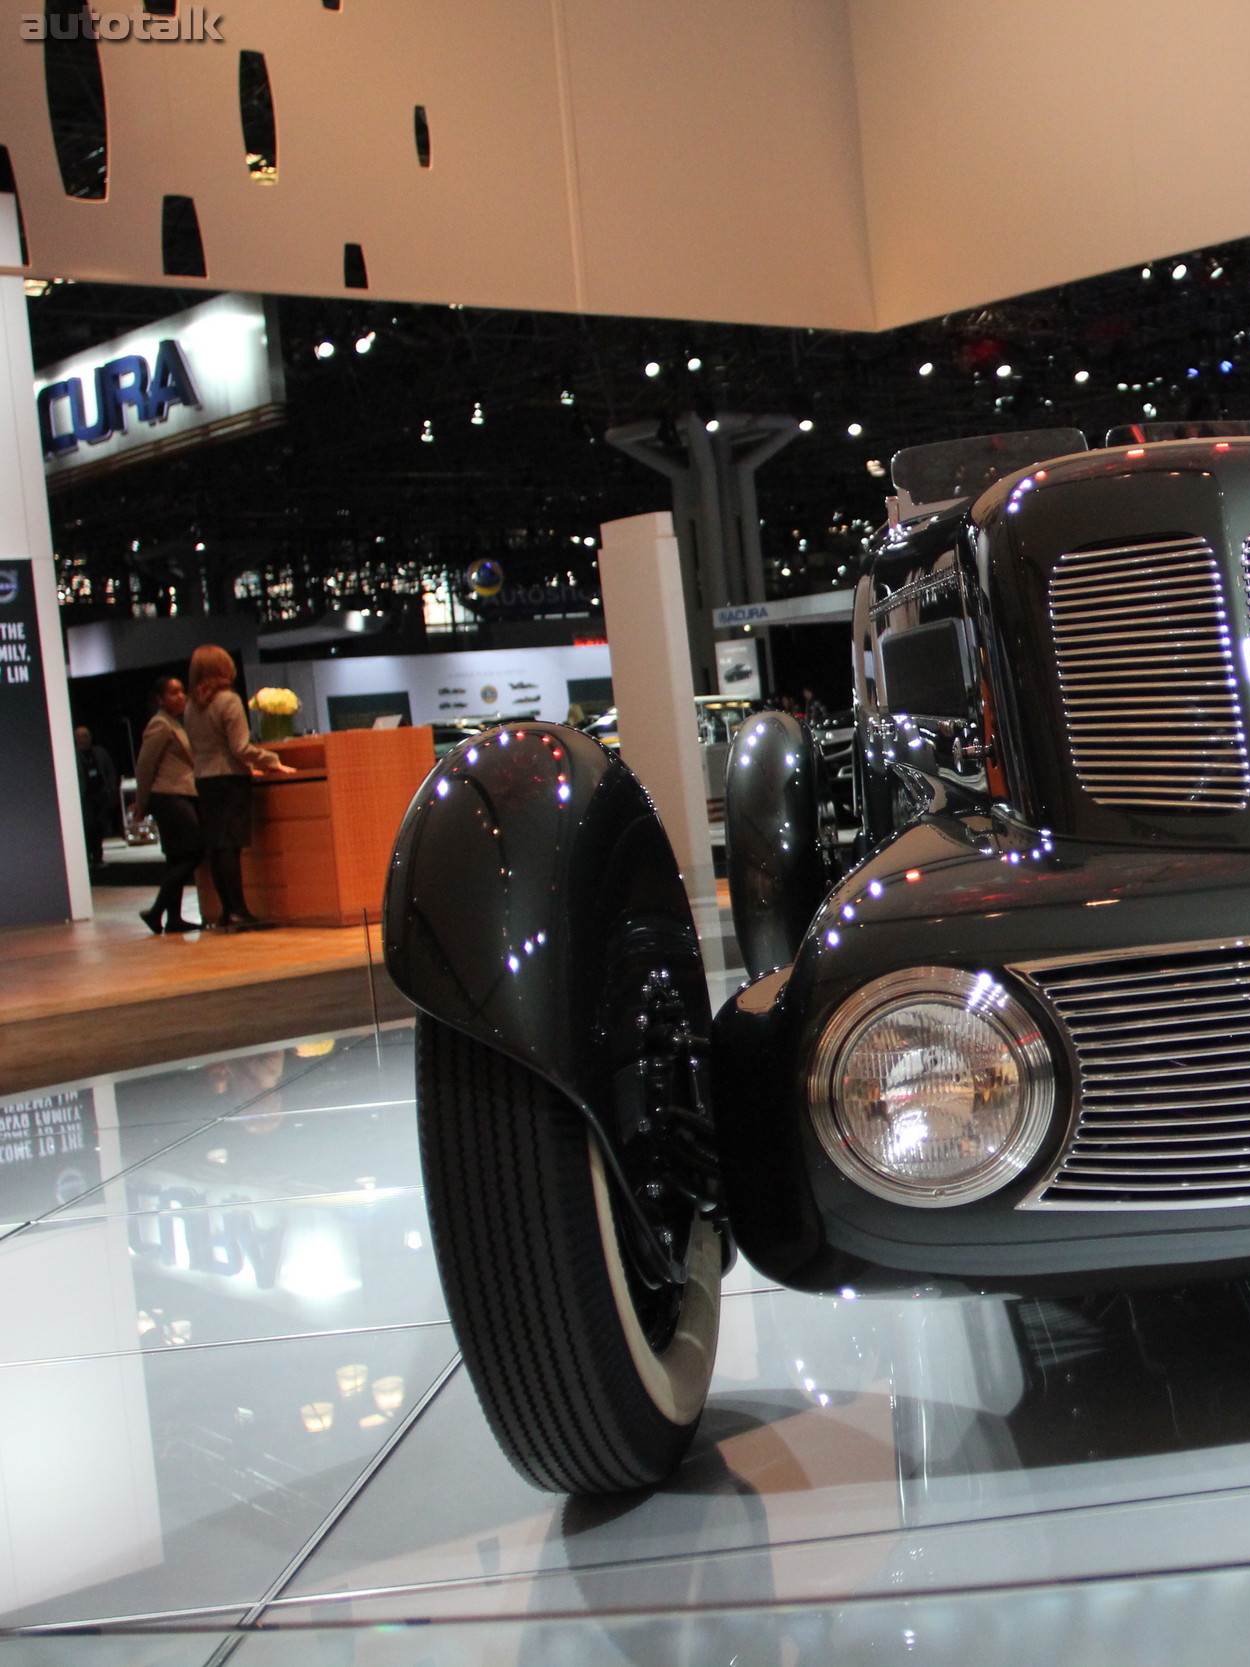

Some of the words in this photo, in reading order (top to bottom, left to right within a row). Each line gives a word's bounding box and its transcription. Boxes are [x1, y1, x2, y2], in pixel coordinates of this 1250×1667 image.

[727, 606, 768, 622] ACURA
[0, 622, 26, 640] THE
[7, 665, 29, 684] LIN
